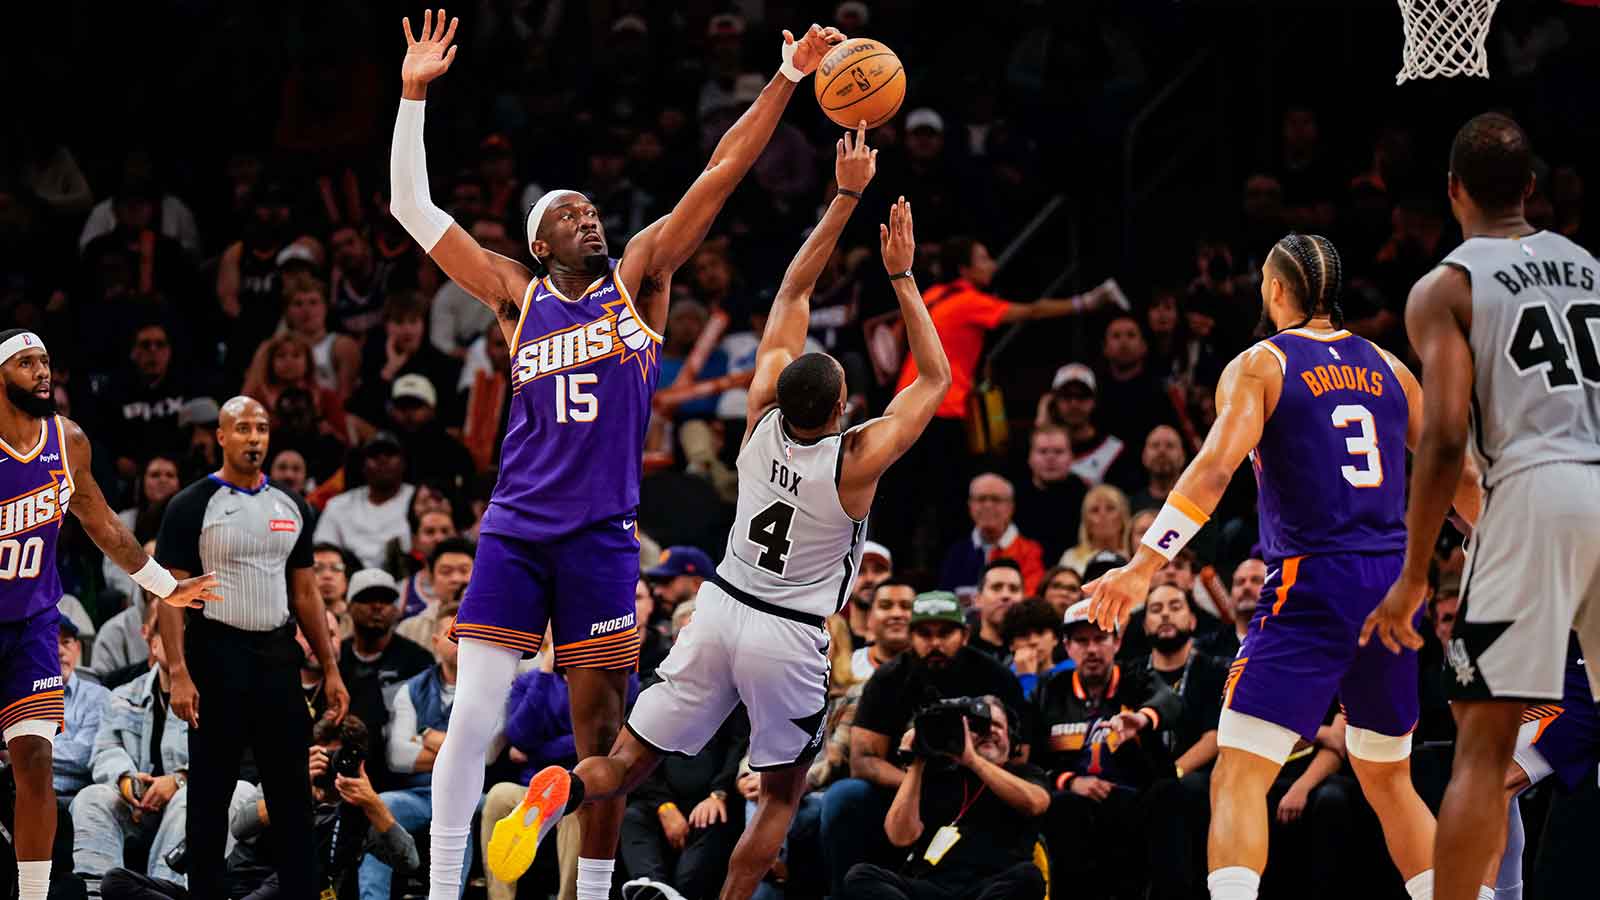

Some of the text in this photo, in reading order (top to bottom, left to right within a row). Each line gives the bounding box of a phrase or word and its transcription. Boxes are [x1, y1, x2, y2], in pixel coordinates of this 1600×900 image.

[1493, 261, 1594, 295] BARNES
[518, 319, 614, 382] SUNS
[1504, 299, 1600, 393] 40
[555, 373, 599, 423] 15
[1300, 364, 1384, 397] BROOKS
[1331, 404, 1384, 488] 3
[769, 459, 802, 496] FOX
[0, 536, 44, 580] 00
[746, 499, 797, 579] 4
